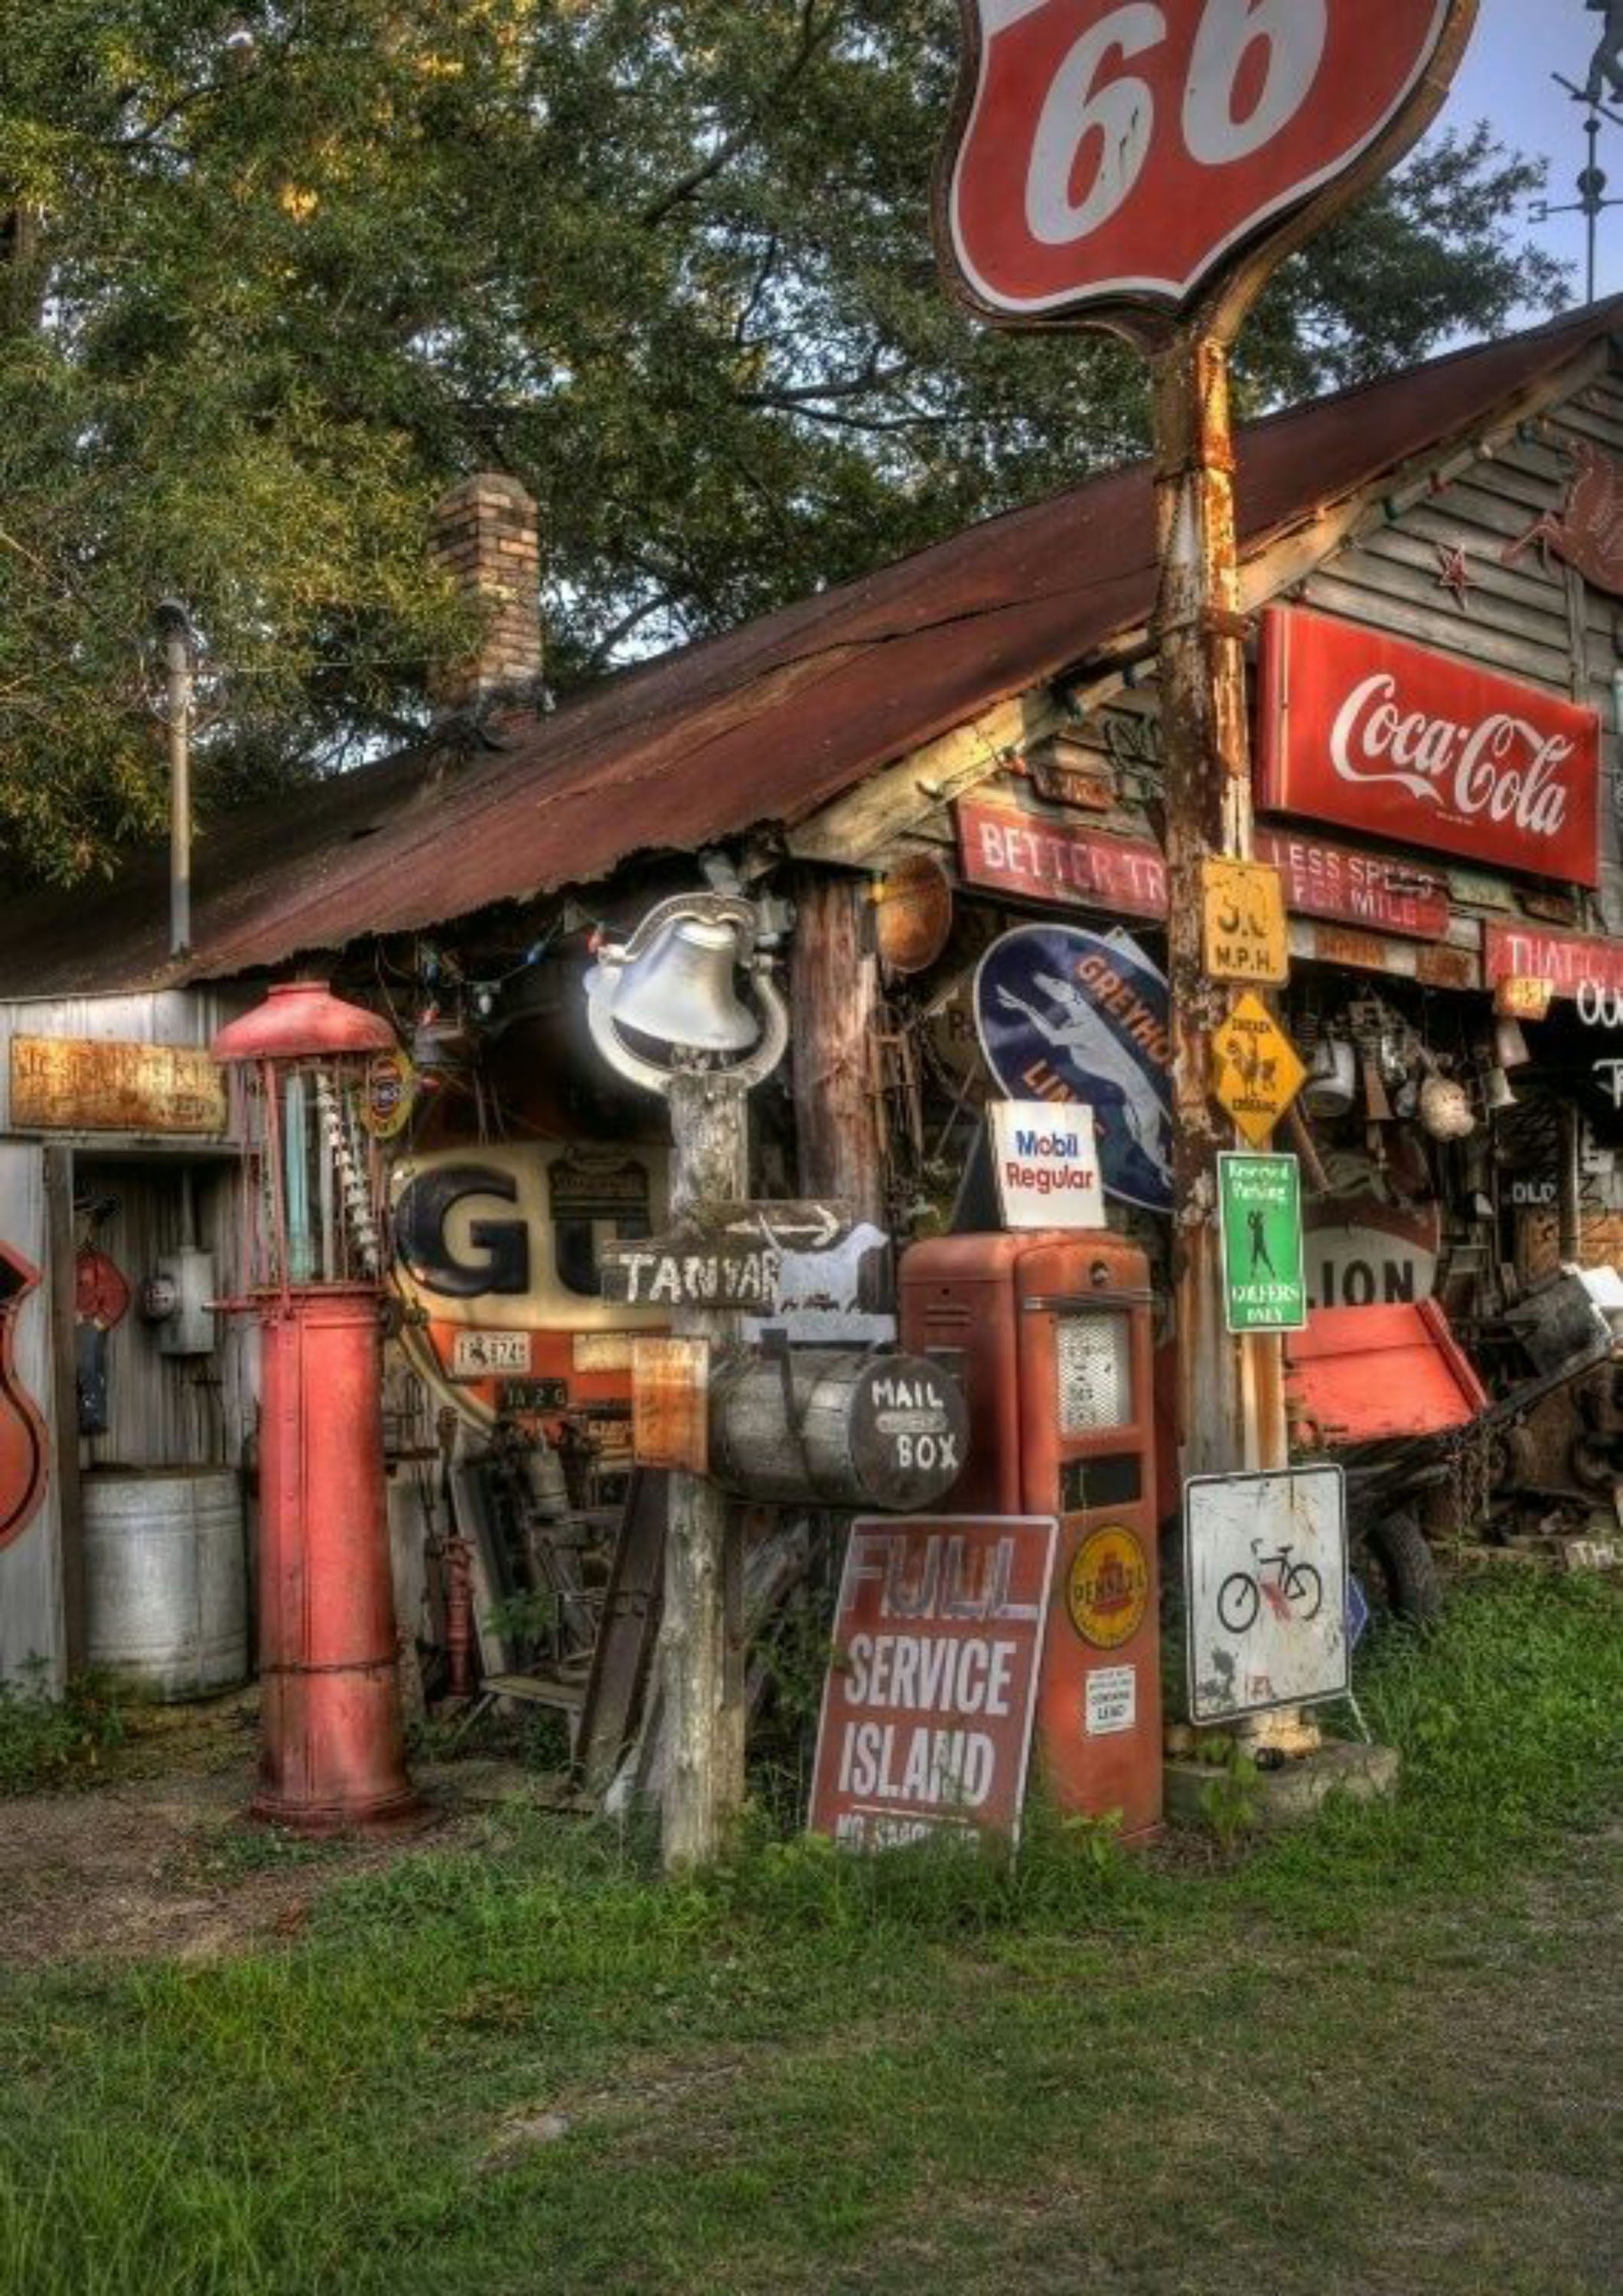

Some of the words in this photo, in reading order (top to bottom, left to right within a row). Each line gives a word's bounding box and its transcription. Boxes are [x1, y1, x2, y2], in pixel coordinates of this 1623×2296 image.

[1025, 0, 1328, 245] 66
[979, 821, 1112, 892] BETTER
[1271, 839, 1341, 880] LESS
[1349, 885, 1417, 925] MILE
[1215, 943, 1277, 974] M.P.H.
[1015, 1130, 1078, 1158] Mobil
[1005, 1161, 1093, 1195] Regular
[871, 1378, 944, 1408] MAIL
[897, 1433, 958, 1469] BOX
[842, 1534, 1038, 1620] FULL
[846, 1632, 1017, 1716] SERVICE
[837, 1721, 996, 1807] ISLAND
